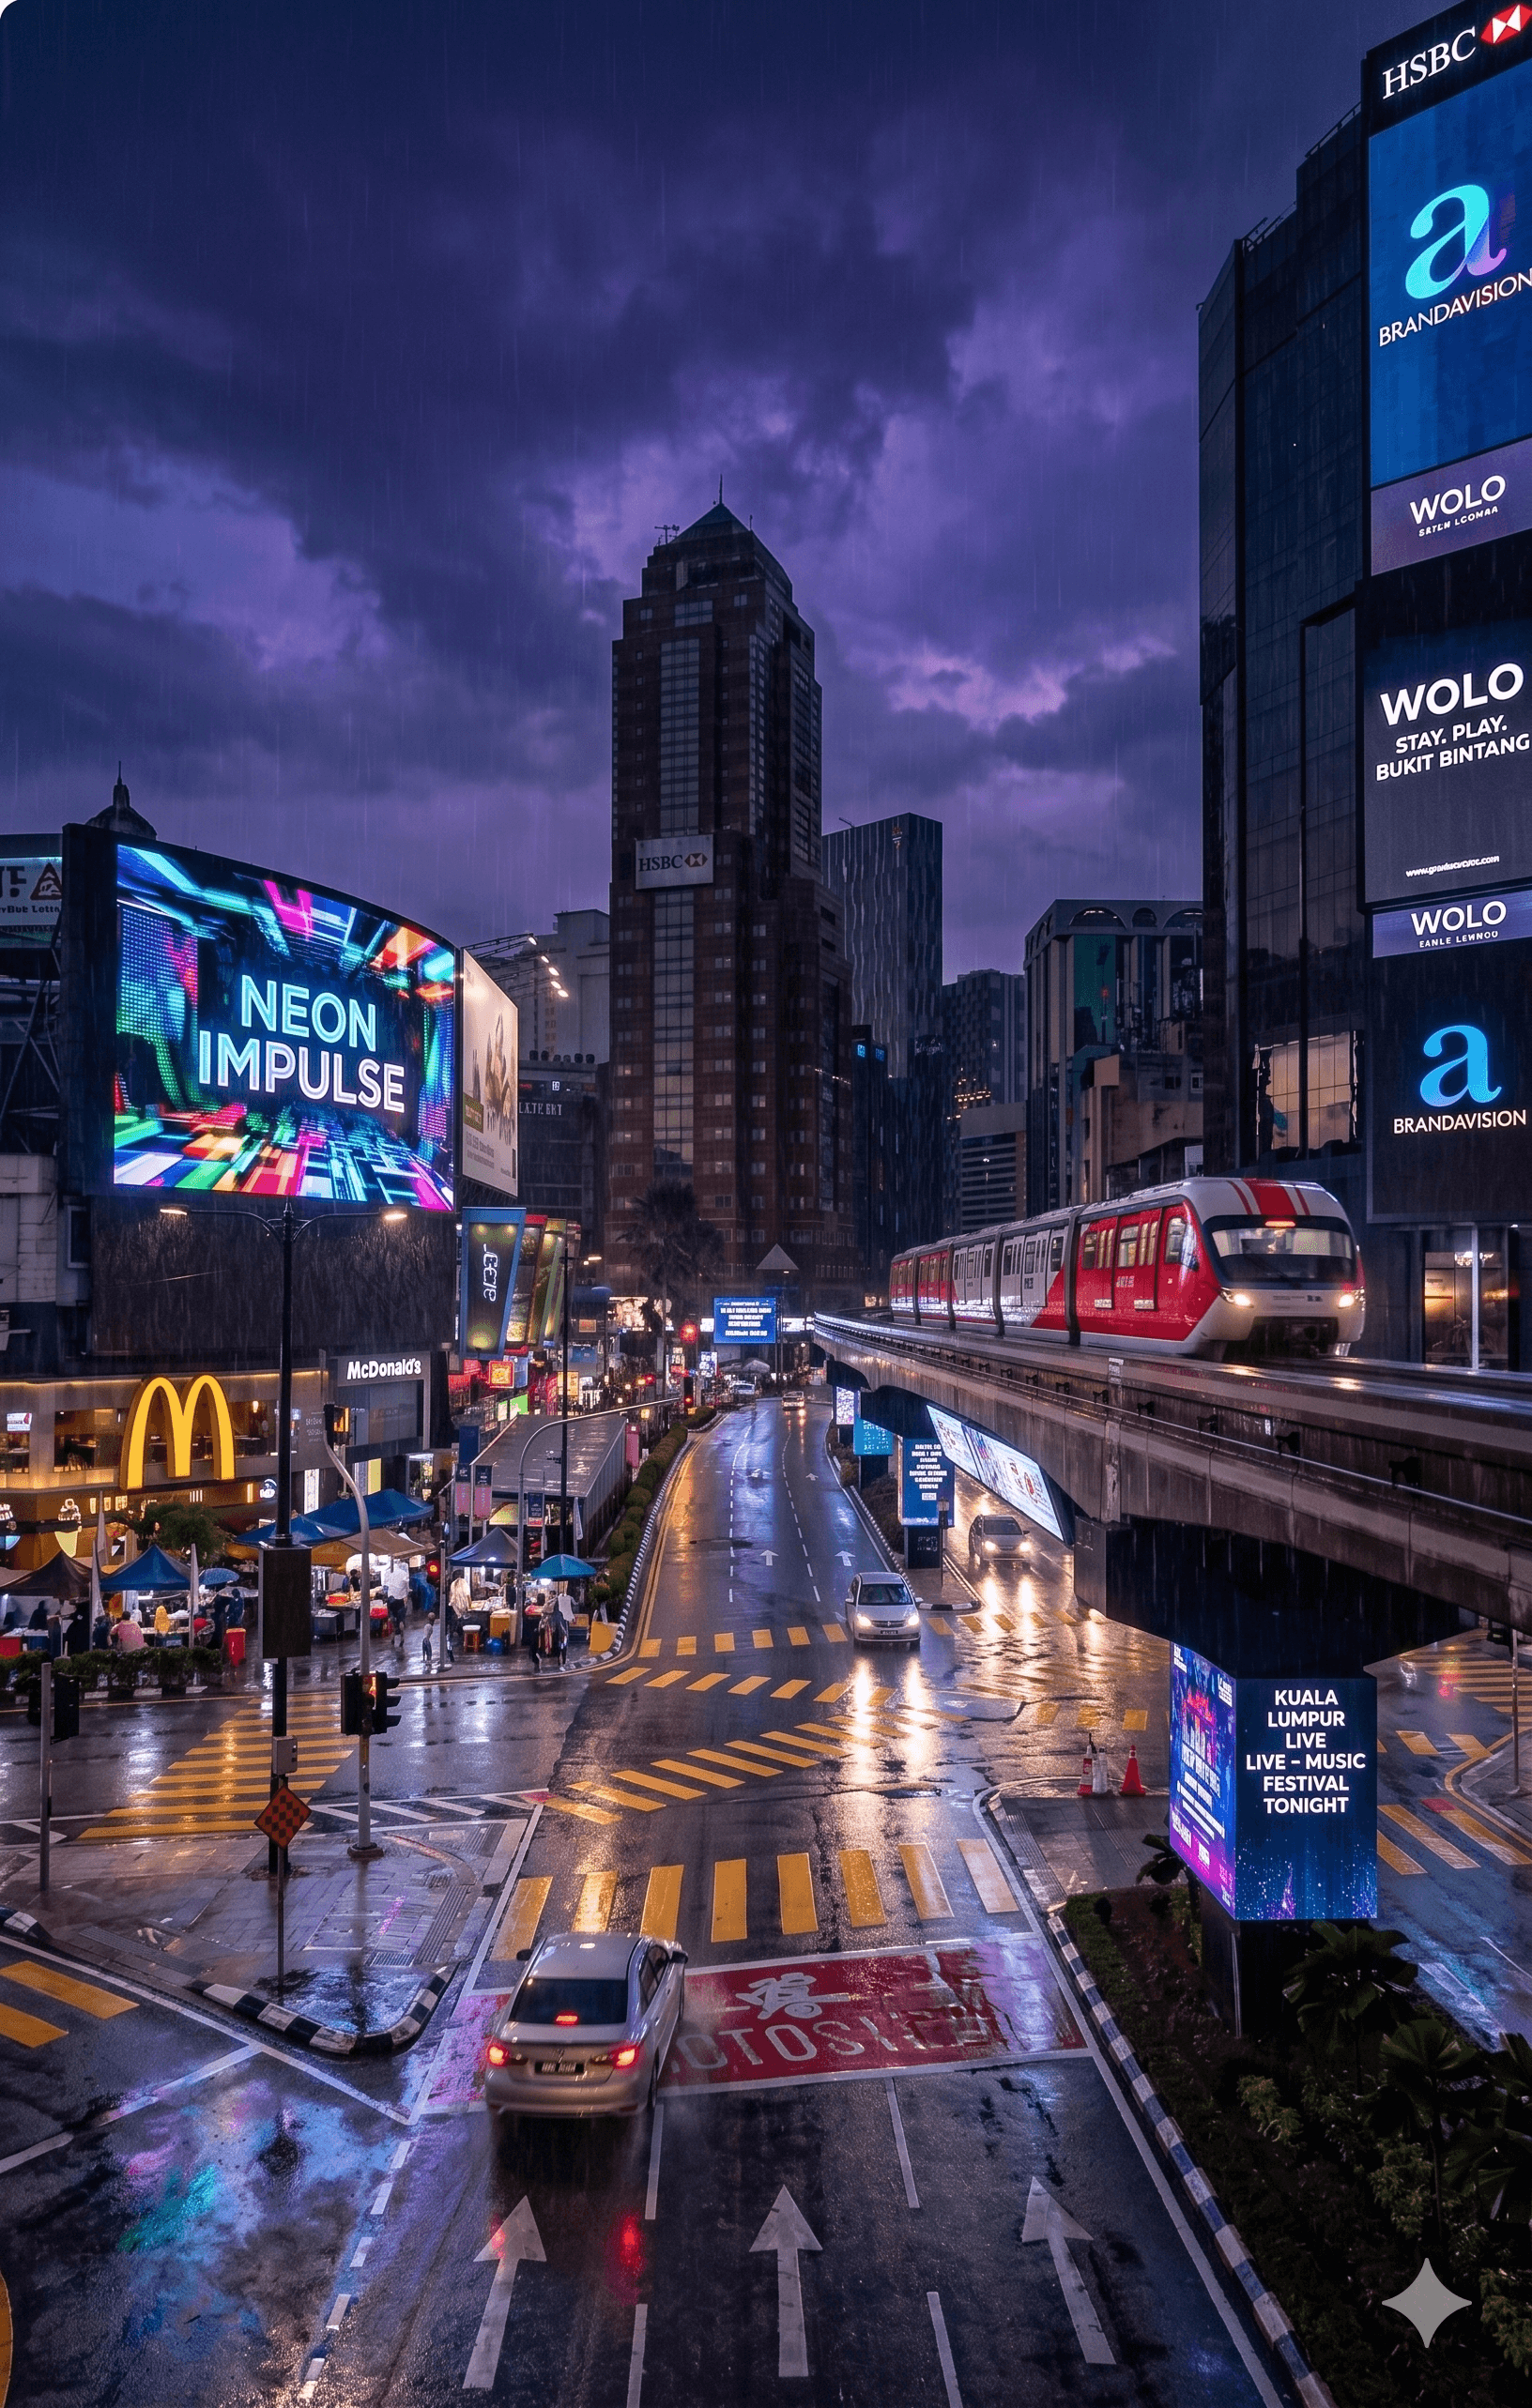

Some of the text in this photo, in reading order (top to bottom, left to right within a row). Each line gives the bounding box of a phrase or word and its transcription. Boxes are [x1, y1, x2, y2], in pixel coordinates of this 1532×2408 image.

[1382, 25, 1477, 99] HSBC
[1379, 267, 1532, 347] BRANDAVISION
[1409, 475, 1507, 525] WOLO
[1379, 663, 1524, 726] WOLO
[1395, 714, 1508, 754] STAY. PLAY.
[1376, 733, 1530, 782] BUKIT BINTANG
[638, 855, 683, 872] HSBC
[1410, 900, 1507, 937] WOLO
[241, 974, 375, 1052] NEON
[199, 1029, 405, 1113] IMPULSE
[1393, 1109, 1526, 1135] BRANDAVISION
[346, 1357, 421, 1380] McDonald's
[1275, 1689, 1339, 1706] KUALA
[1267, 1711, 1346, 1728] LUMPUR
[1285, 1732, 1326, 1749] LIVE
[1246, 1754, 1286, 1771] LIVE
[1305, 1753, 1366, 1770] MUSIC
[1264, 1776, 1350, 1792] FESTIVAL
[1264, 1797, 1350, 1814] TONIGHT
